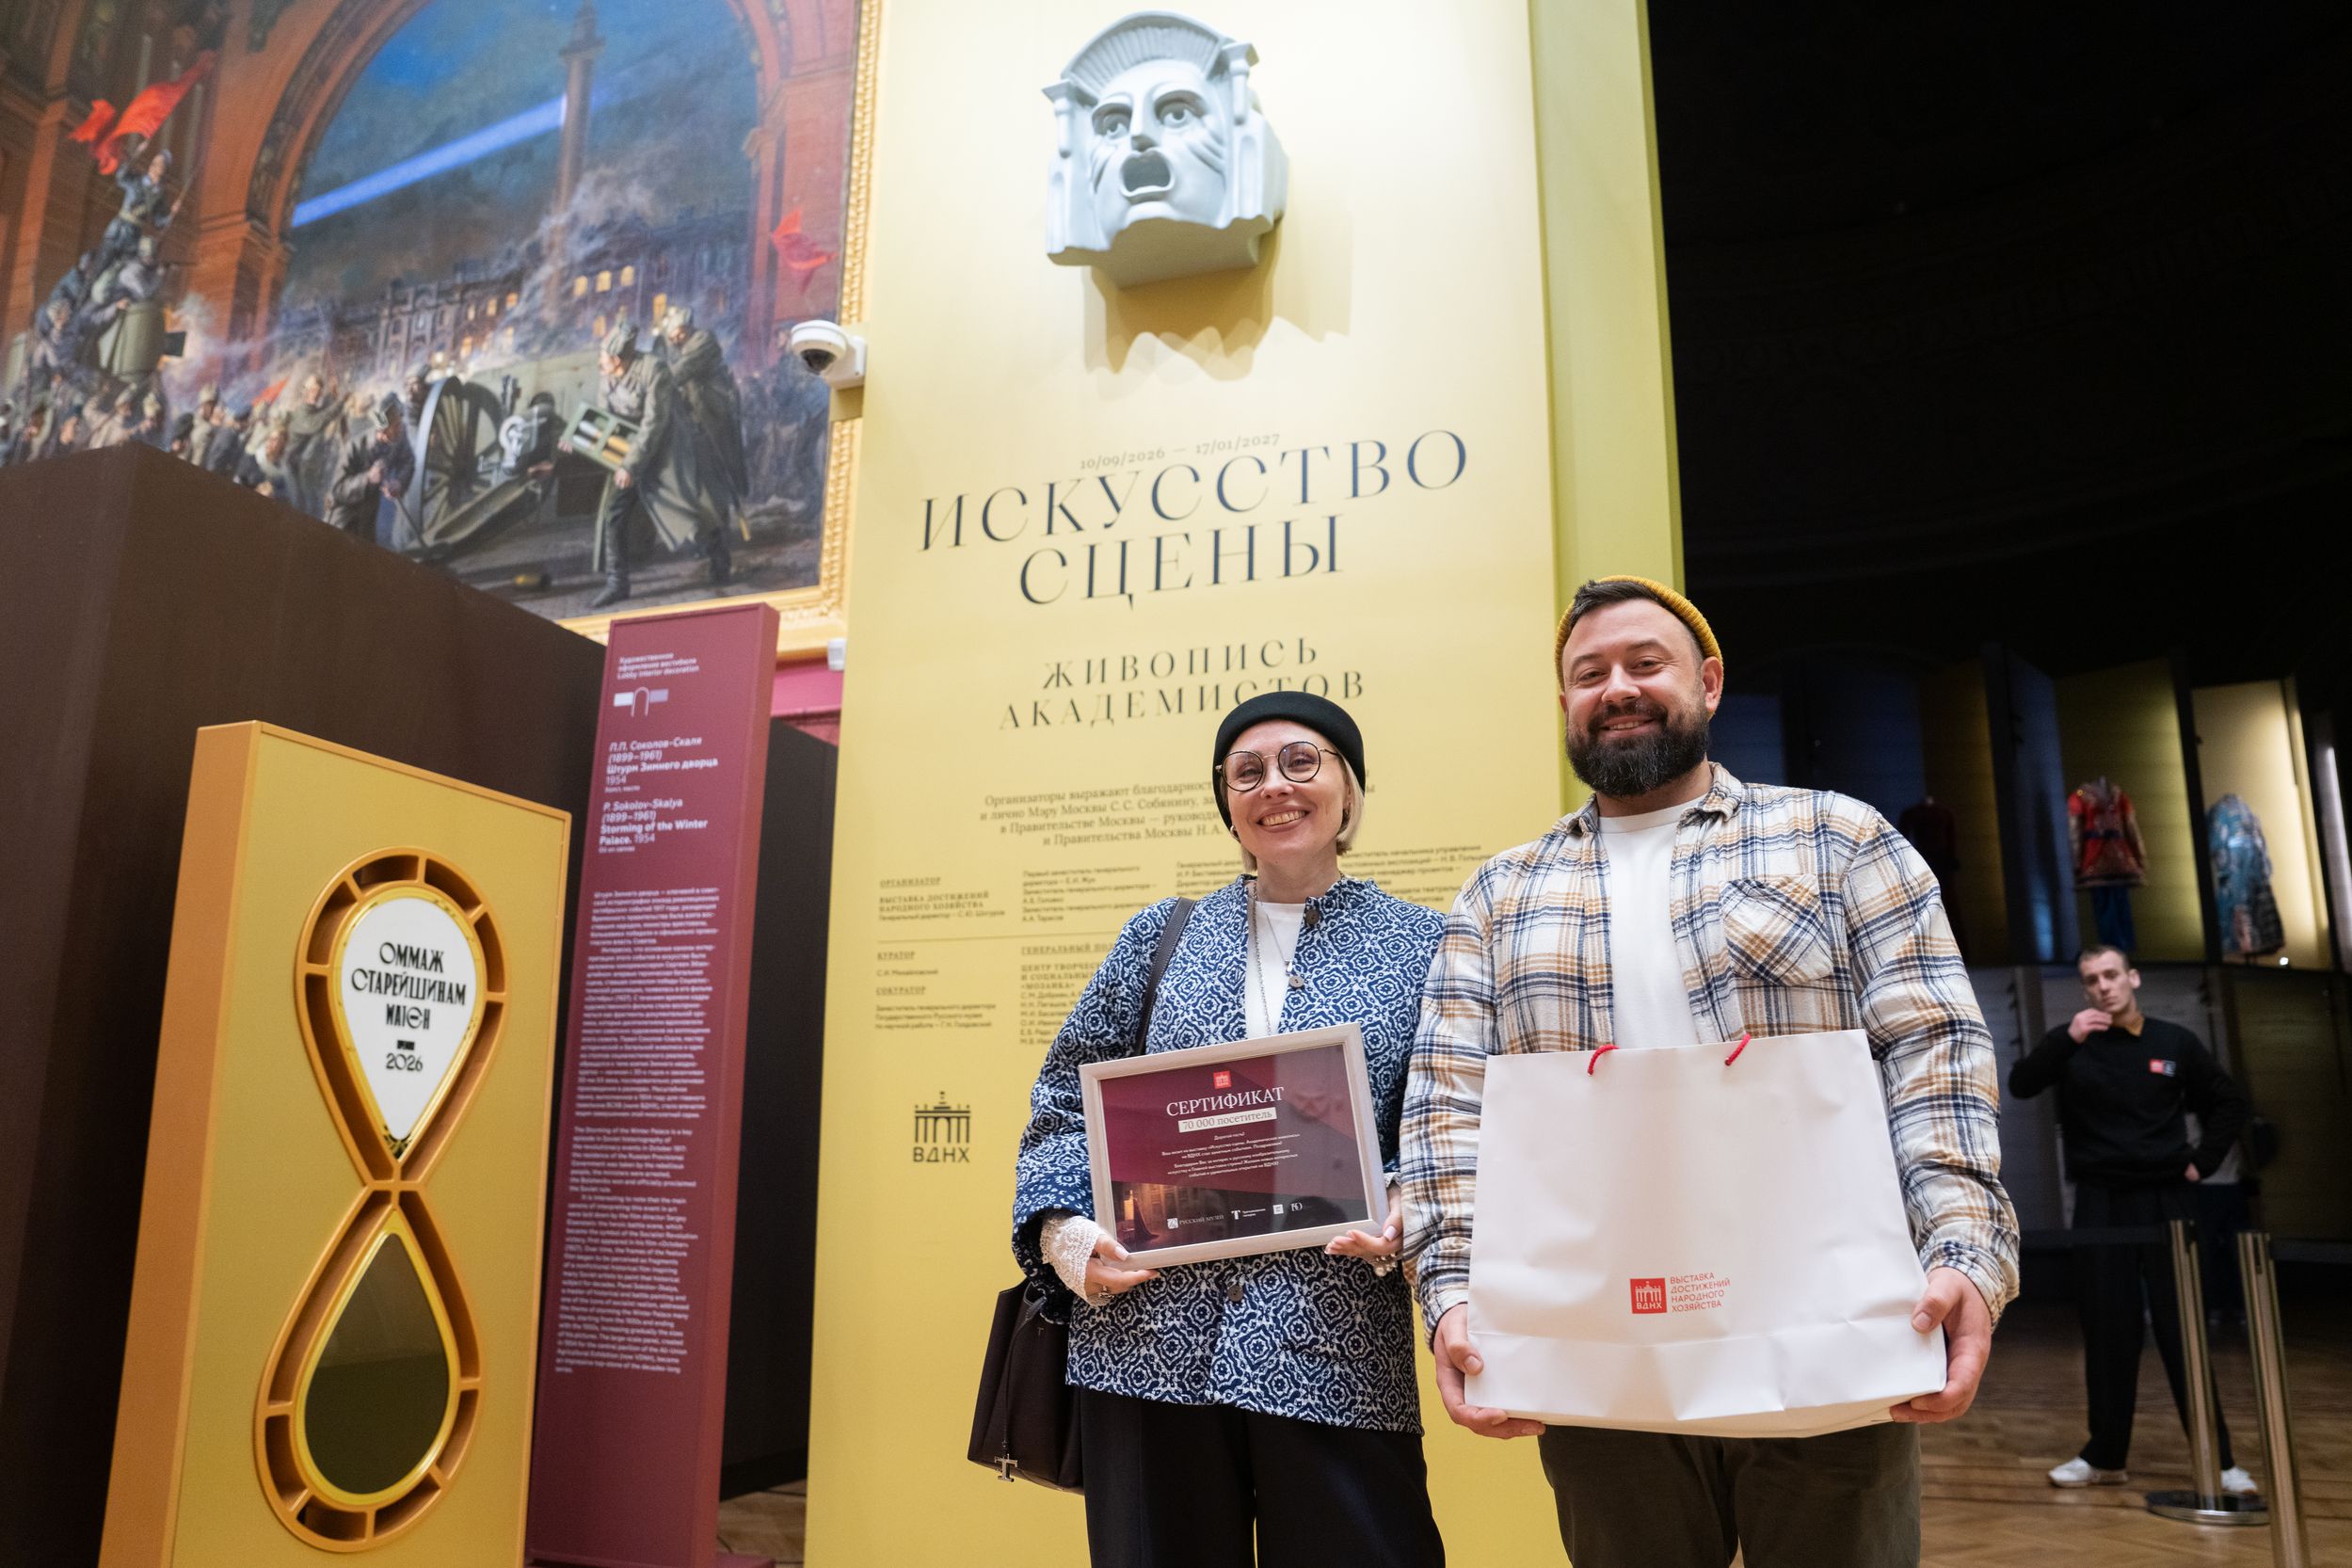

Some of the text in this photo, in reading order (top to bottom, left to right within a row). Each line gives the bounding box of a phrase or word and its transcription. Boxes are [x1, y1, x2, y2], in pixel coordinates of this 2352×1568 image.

[1080, 446, 1165, 470] 10/09/2026
[1194, 434, 1281, 456] 17/01/2027
[918, 429, 1467, 552] ИСКУССТВО
[1018, 515, 1344, 611] СЦЕНЫ
[1043, 636, 1318, 689] ЖИВОПИСЬ
[640, 760, 680, 772] Зимнего
[681, 758, 718, 769] дворца
[606, 775, 626, 785] 1954
[984, 780, 1213, 808] Организаторы выражают благодарност
[614, 798, 683, 810] Sokolov-Skalya
[980, 812, 986, 821] и
[990, 809, 1025, 820] лично
[1028, 806, 1058, 819] Мэру
[1060, 803, 1107, 816] Москвы
[1138, 795, 1199, 809] Собянину,
[600, 819, 708, 835] Storming of the Winter
[1010, 818, 1095, 835] Правительстве
[1097, 815, 1144, 827] Москвы
[634, 834, 655, 843] 1954
[1054, 829, 1142, 847] Правительства
[1144, 827, 1192, 840] Москвы
[880, 877, 941, 888] ОРГАНИЗАТОР
[927, 890, 989, 902] ДОСТИЖЕНИЙ
[933, 901, 984, 909] ХОЗЯЙСТВА
[379, 942, 444, 973] ОММАЖ
[352, 968, 467, 1005] СТАРЕЙШИНАМ
[386, 1052, 424, 1072] 2026
[1166, 1086, 1284, 1117] СЕРТИФИКАТ
[1182, 1110, 1272, 1130] 70 000 посетитель
[913, 1146, 969, 1162] ВДНХ
[1671, 1272, 1715, 1284] ВЫСТАВКА
[1671, 1278, 1731, 1294] ДОСТИЖЕНИЙ
[1672, 1289, 1724, 1304] НАРОДНОГО
[1672, 1300, 1721, 1312] ХОЗЯЙСТВА
